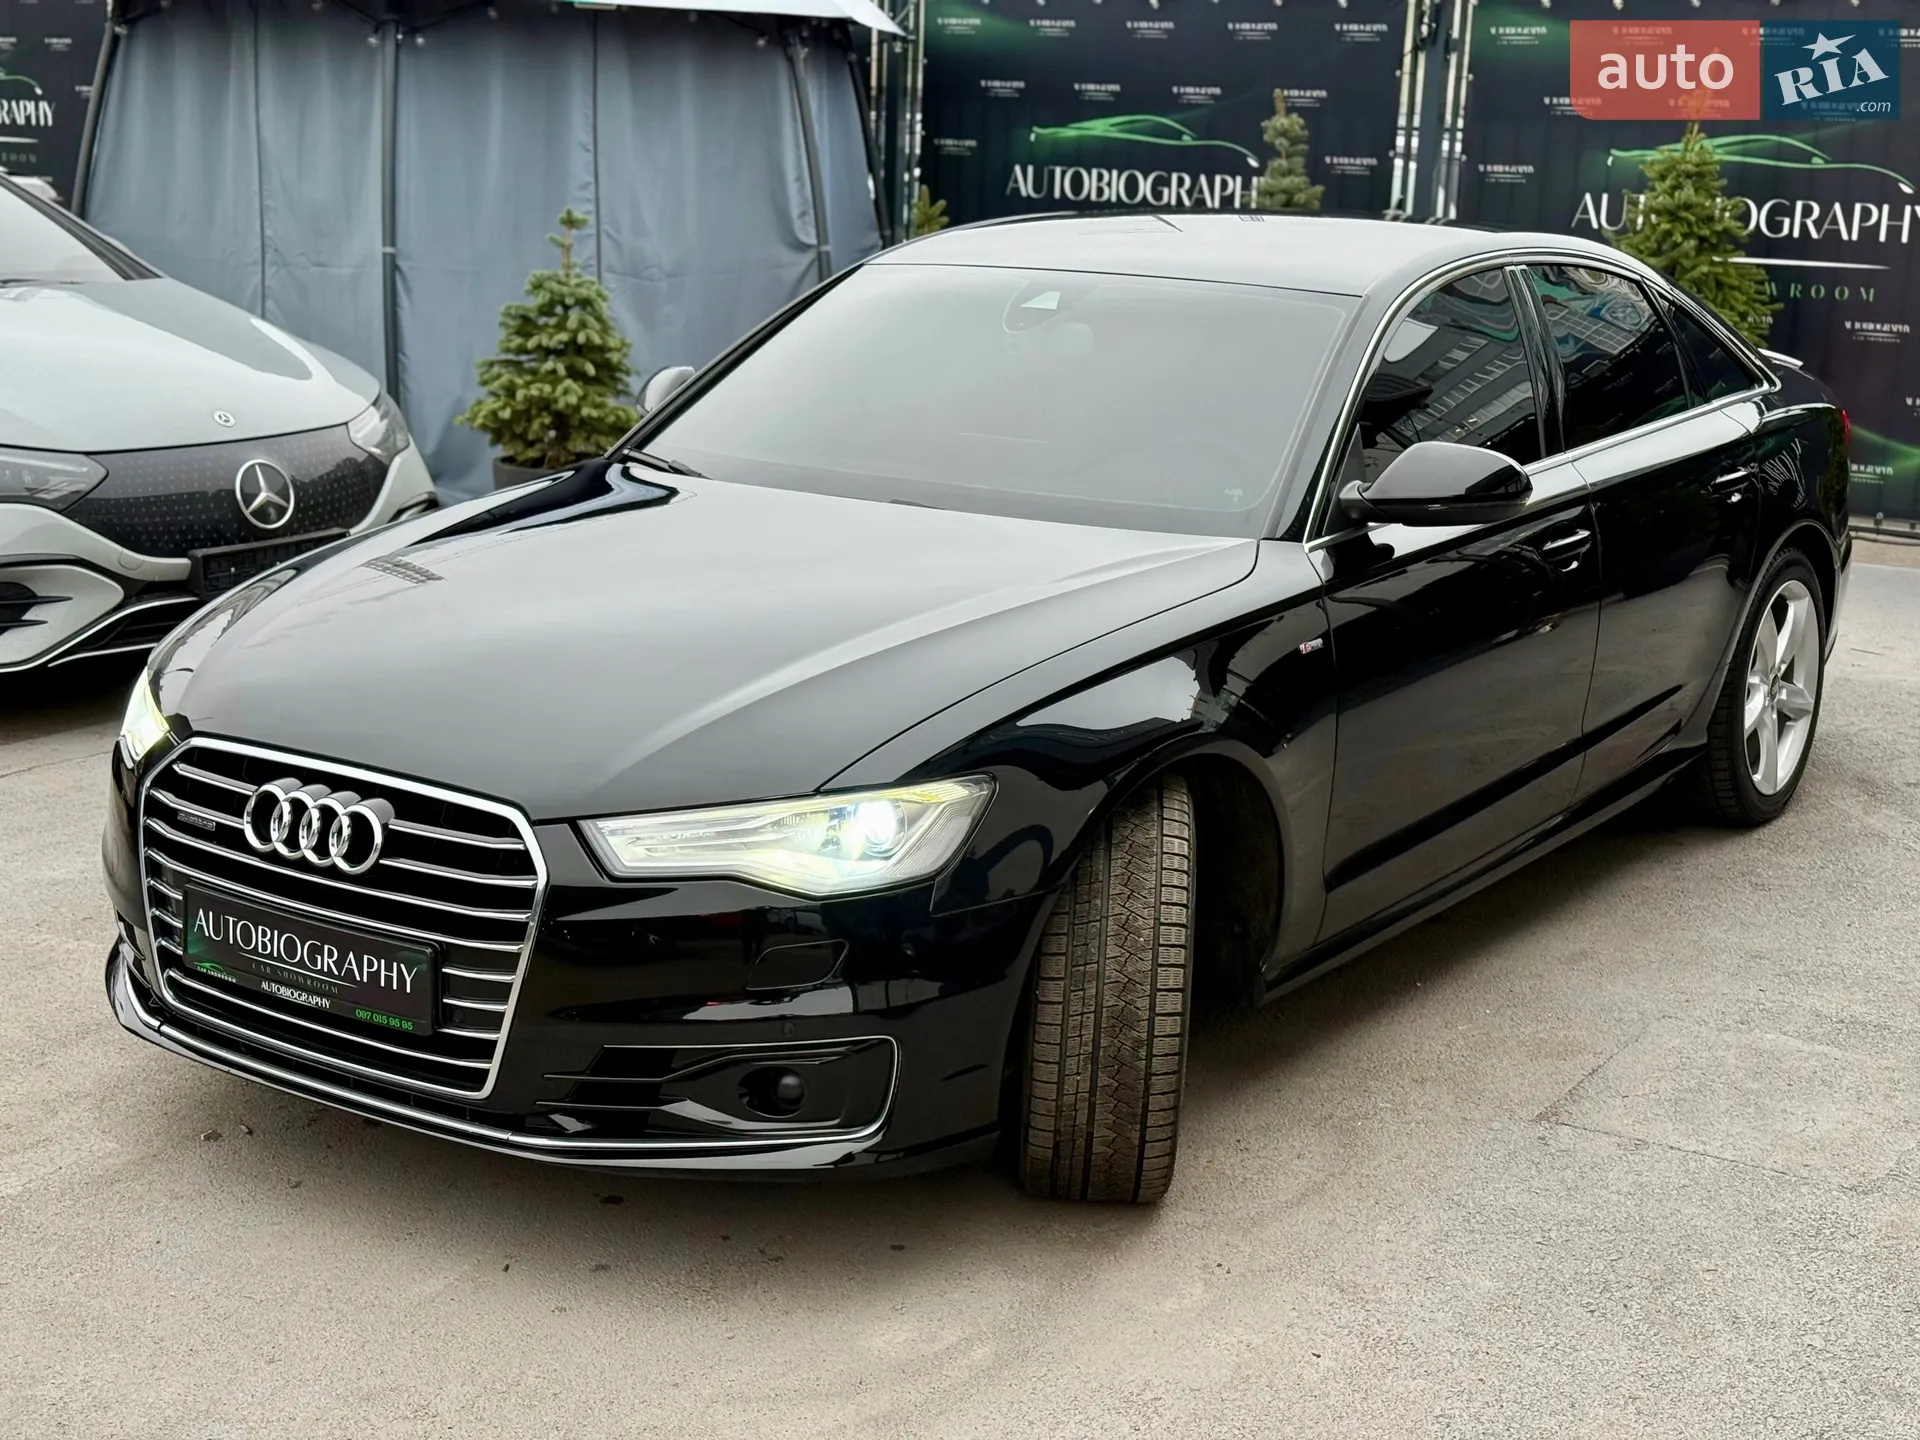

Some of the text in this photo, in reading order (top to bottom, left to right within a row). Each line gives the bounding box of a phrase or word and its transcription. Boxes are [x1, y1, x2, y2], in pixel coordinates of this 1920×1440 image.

[1005, 163, 1259, 210] AUTOBIOGRAPH
[194, 907, 418, 994] AUTOBIOGRAPHY
[261, 981, 331, 1009] AUTOBIOGRAPHY
[277, 969, 339, 994] SHOWROOM
[355, 1009, 413, 1031] 097 015 95 95
